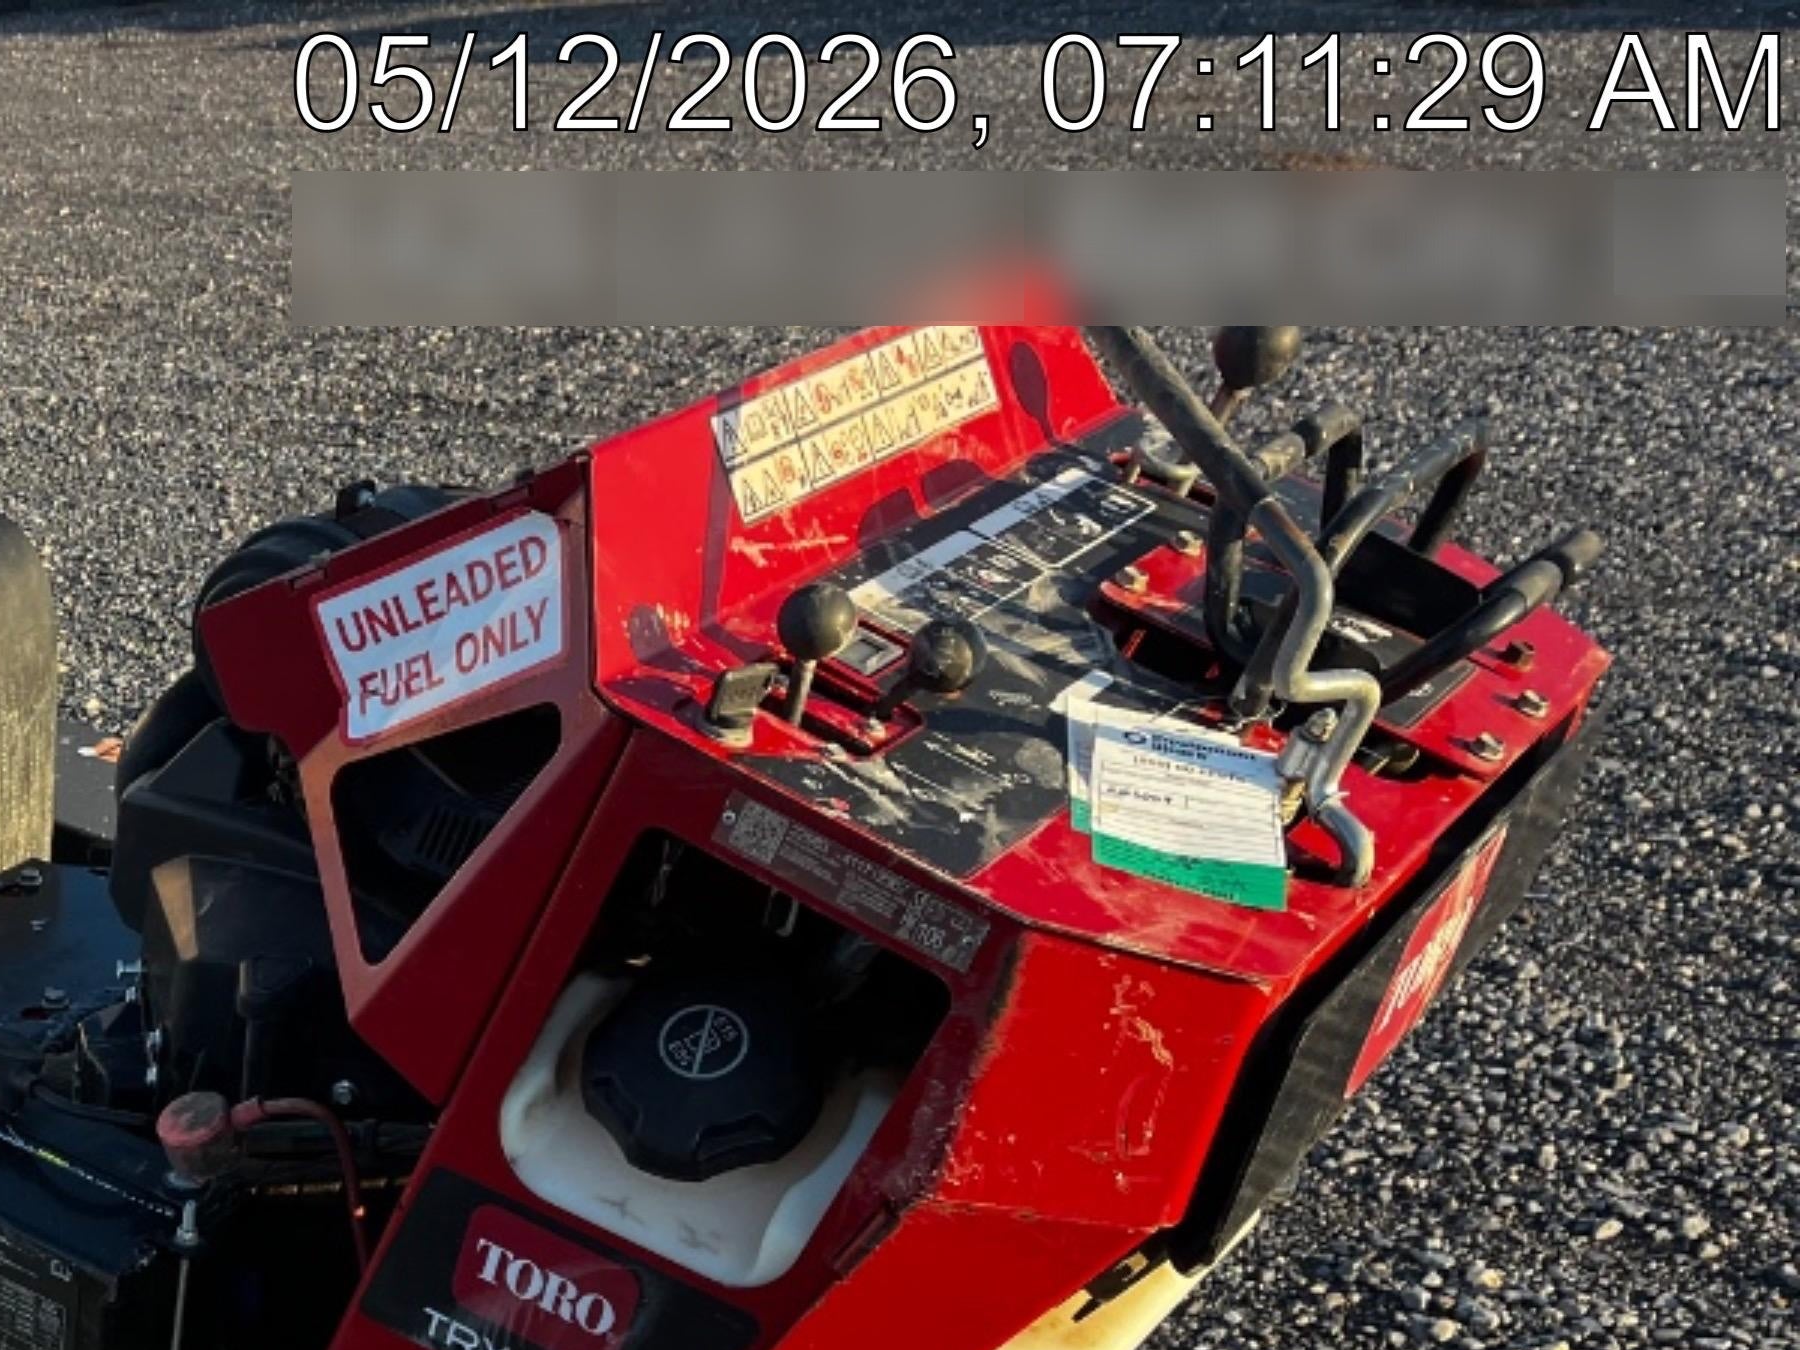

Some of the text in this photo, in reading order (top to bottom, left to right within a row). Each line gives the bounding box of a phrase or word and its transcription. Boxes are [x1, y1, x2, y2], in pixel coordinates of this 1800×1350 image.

[335, 535, 548, 653] UNLEADED
[358, 596, 549, 717] FUEL ONLY
[475, 1237, 616, 1337] TORO
